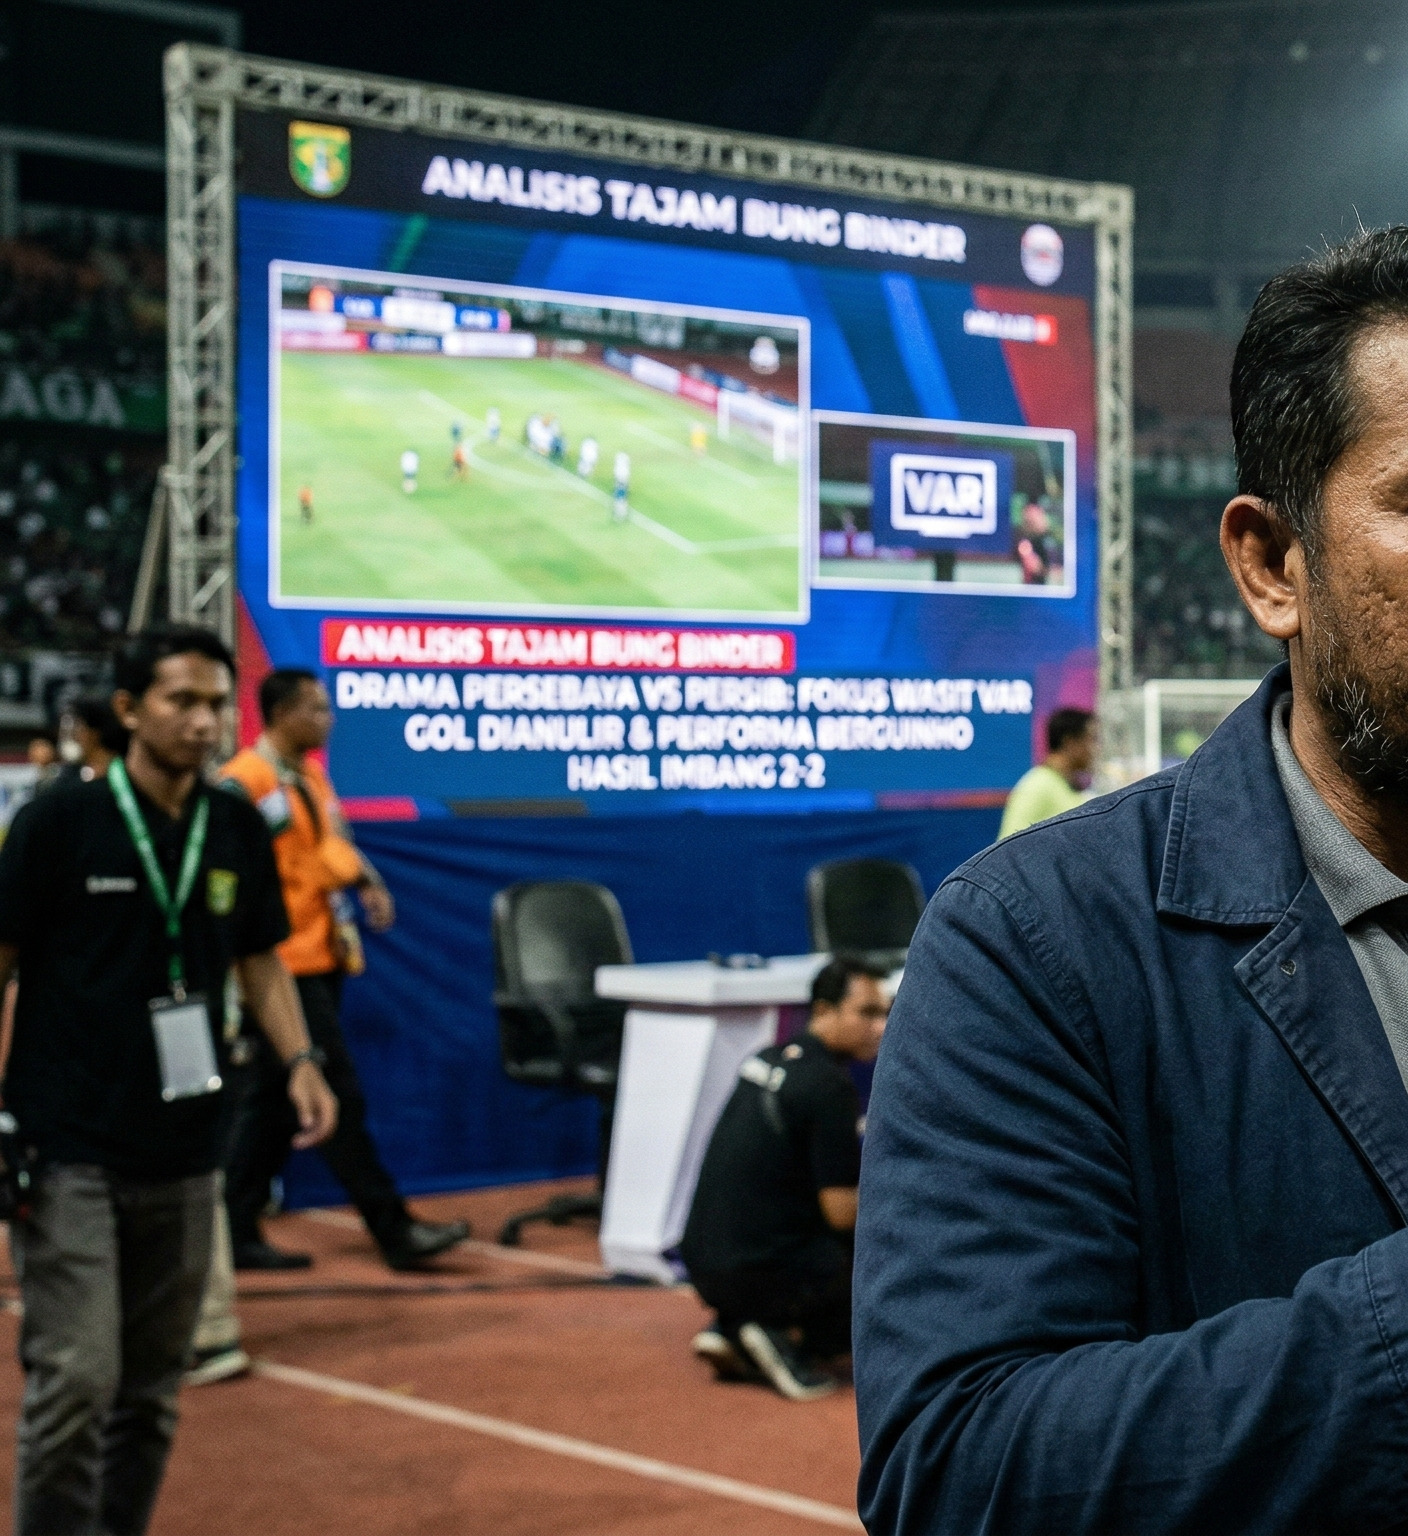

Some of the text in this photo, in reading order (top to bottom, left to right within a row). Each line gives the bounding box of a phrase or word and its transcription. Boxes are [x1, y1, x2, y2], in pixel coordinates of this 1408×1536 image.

[421, 155, 967, 263] ANALISIS TAJAM BUNG BINDER
[904, 470, 984, 516] VAR
[336, 624, 784, 669] ANALISIS TAJAM BUNG BINDER
[336, 671, 1033, 714] DRAMA PERSEBAYA VS PERSIB: FOKUS WASIT VAR
[404, 713, 475, 751] GOL
[477, 714, 625, 751] DIANULIR
[628, 713, 654, 751] &
[656, 714, 816, 751] PERFORMA
[567, 753, 826, 791] HASIL IMBANG 2-2
